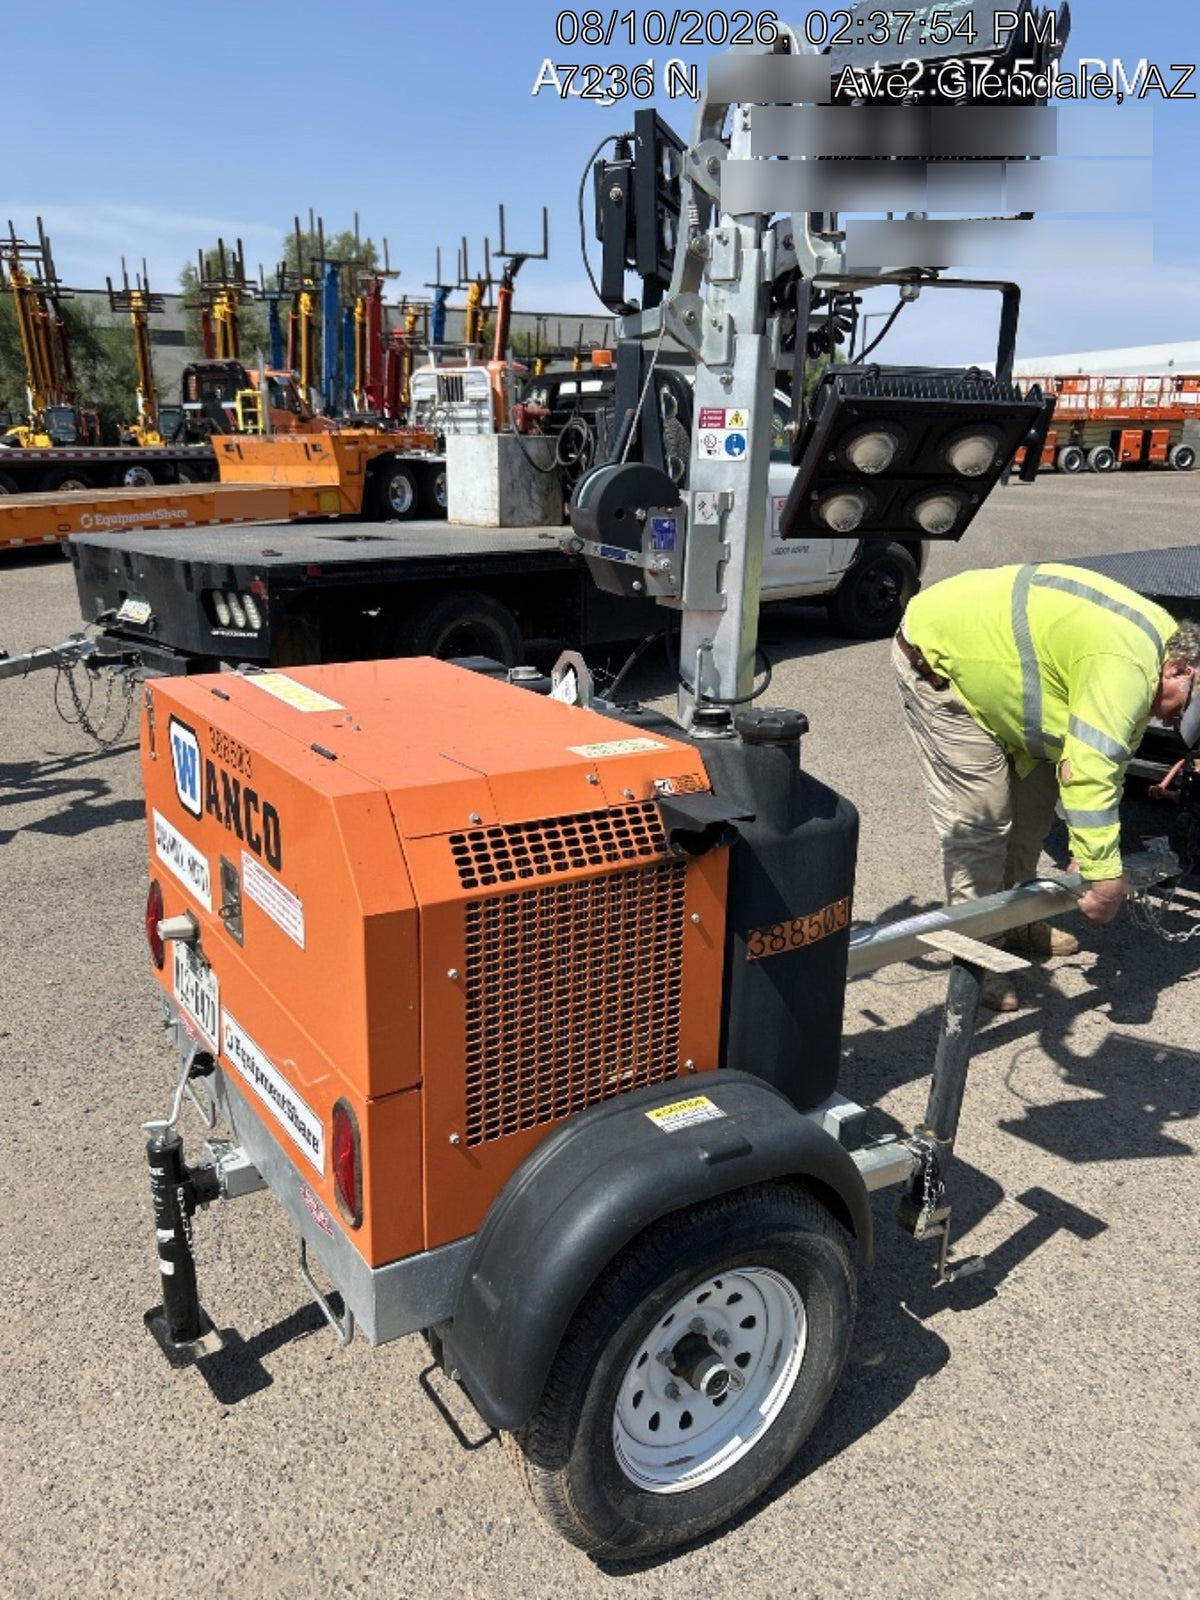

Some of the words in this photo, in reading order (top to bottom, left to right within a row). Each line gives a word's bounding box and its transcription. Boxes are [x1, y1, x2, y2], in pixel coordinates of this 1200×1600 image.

[94, 508, 189, 526] EquipmentShare
[749, 899, 848, 957] 388503
[234, 1034, 320, 1155] EquipmentShare
